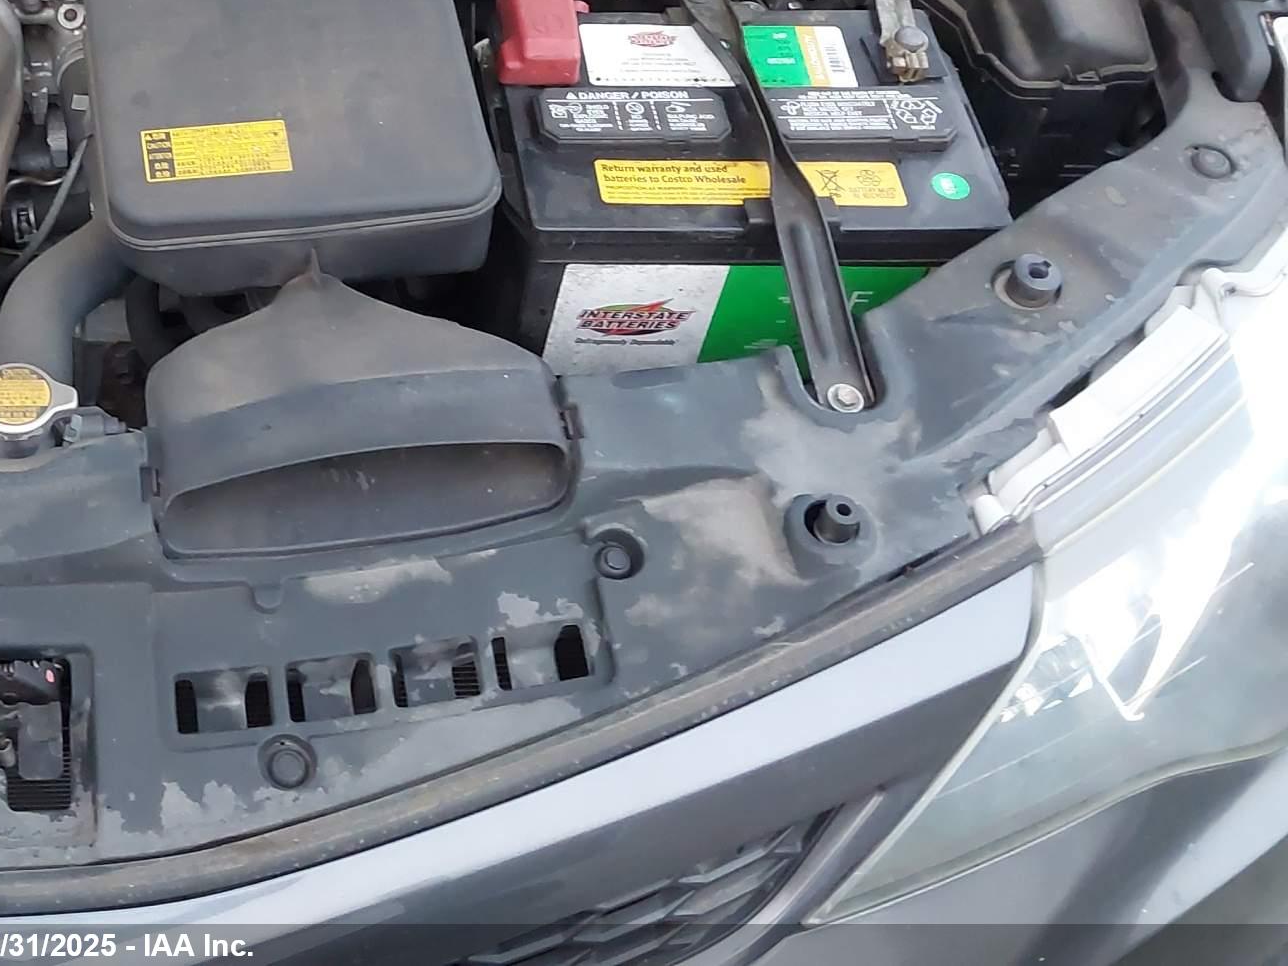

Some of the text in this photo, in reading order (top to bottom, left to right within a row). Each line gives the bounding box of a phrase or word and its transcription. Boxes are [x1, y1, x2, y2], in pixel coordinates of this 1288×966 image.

[578, 92, 630, 100] DANGER
[641, 91, 689, 99] POISON
[601, 164, 728, 174] Return warranty and used
[604, 175, 647, 183] batteries
[694, 176, 746, 184] Wholesale
[579, 310, 691, 320] INTERSTATE
[579, 320, 678, 329] BATTERIES
